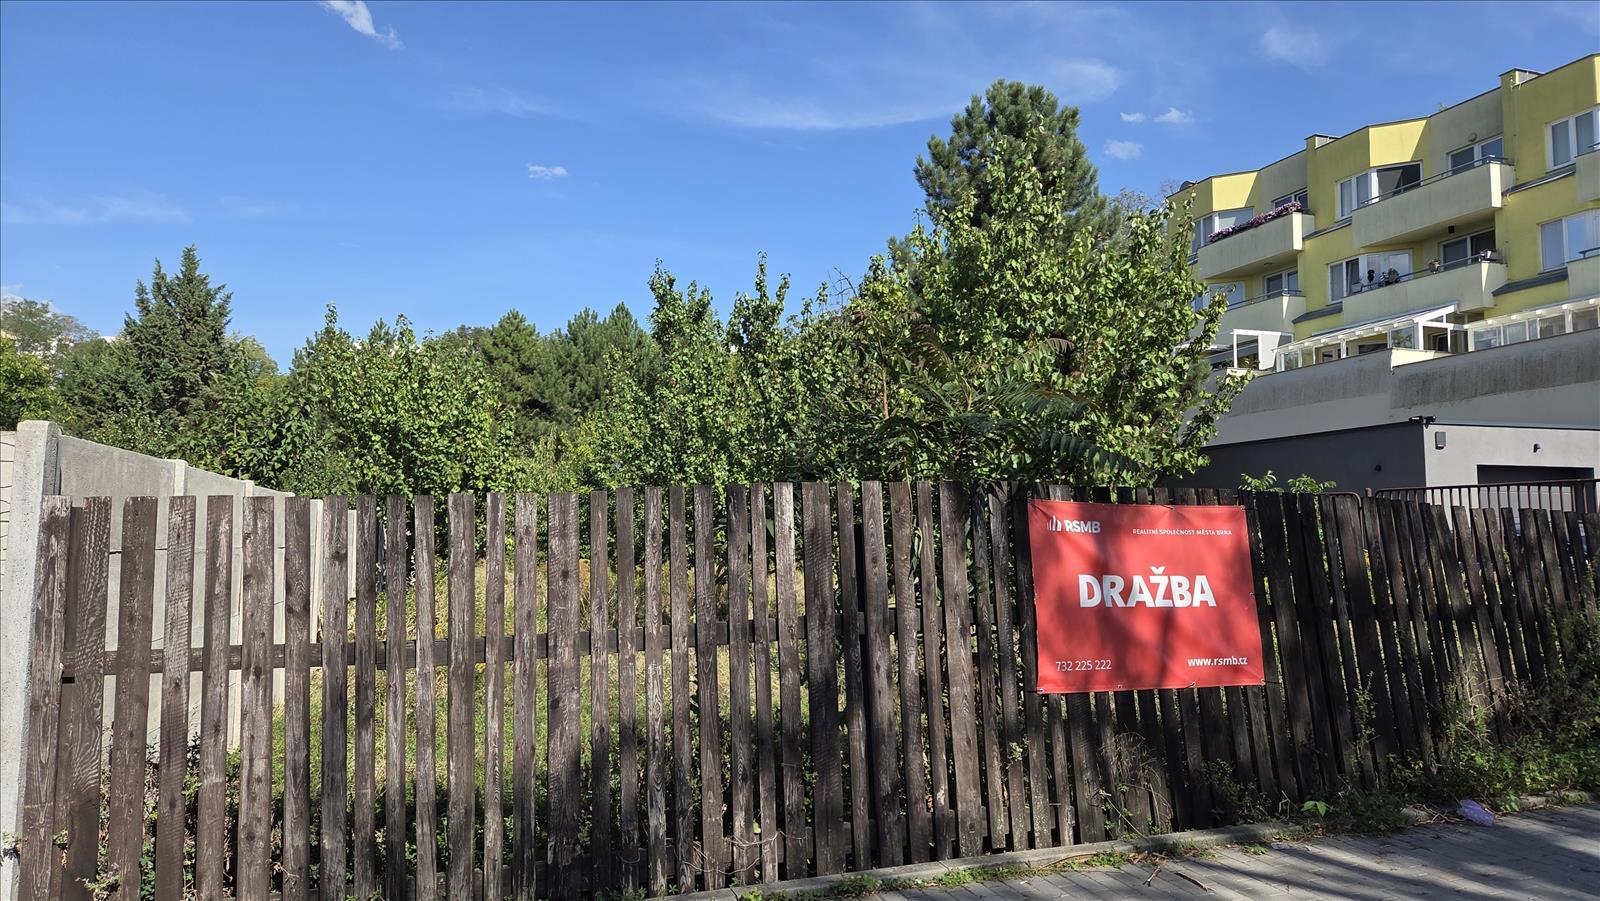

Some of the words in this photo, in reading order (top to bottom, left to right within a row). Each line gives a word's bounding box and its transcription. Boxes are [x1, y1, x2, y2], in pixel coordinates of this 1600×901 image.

[1064, 520, 1101, 533] RSMB
[1078, 566, 1217, 608] DRAŽBA
[1055, 661, 1073, 671] 732
[1075, 660, 1093, 671] 225
[1095, 660, 1112, 670] 222
[1187, 656, 1248, 667] www.rsmb.cz
